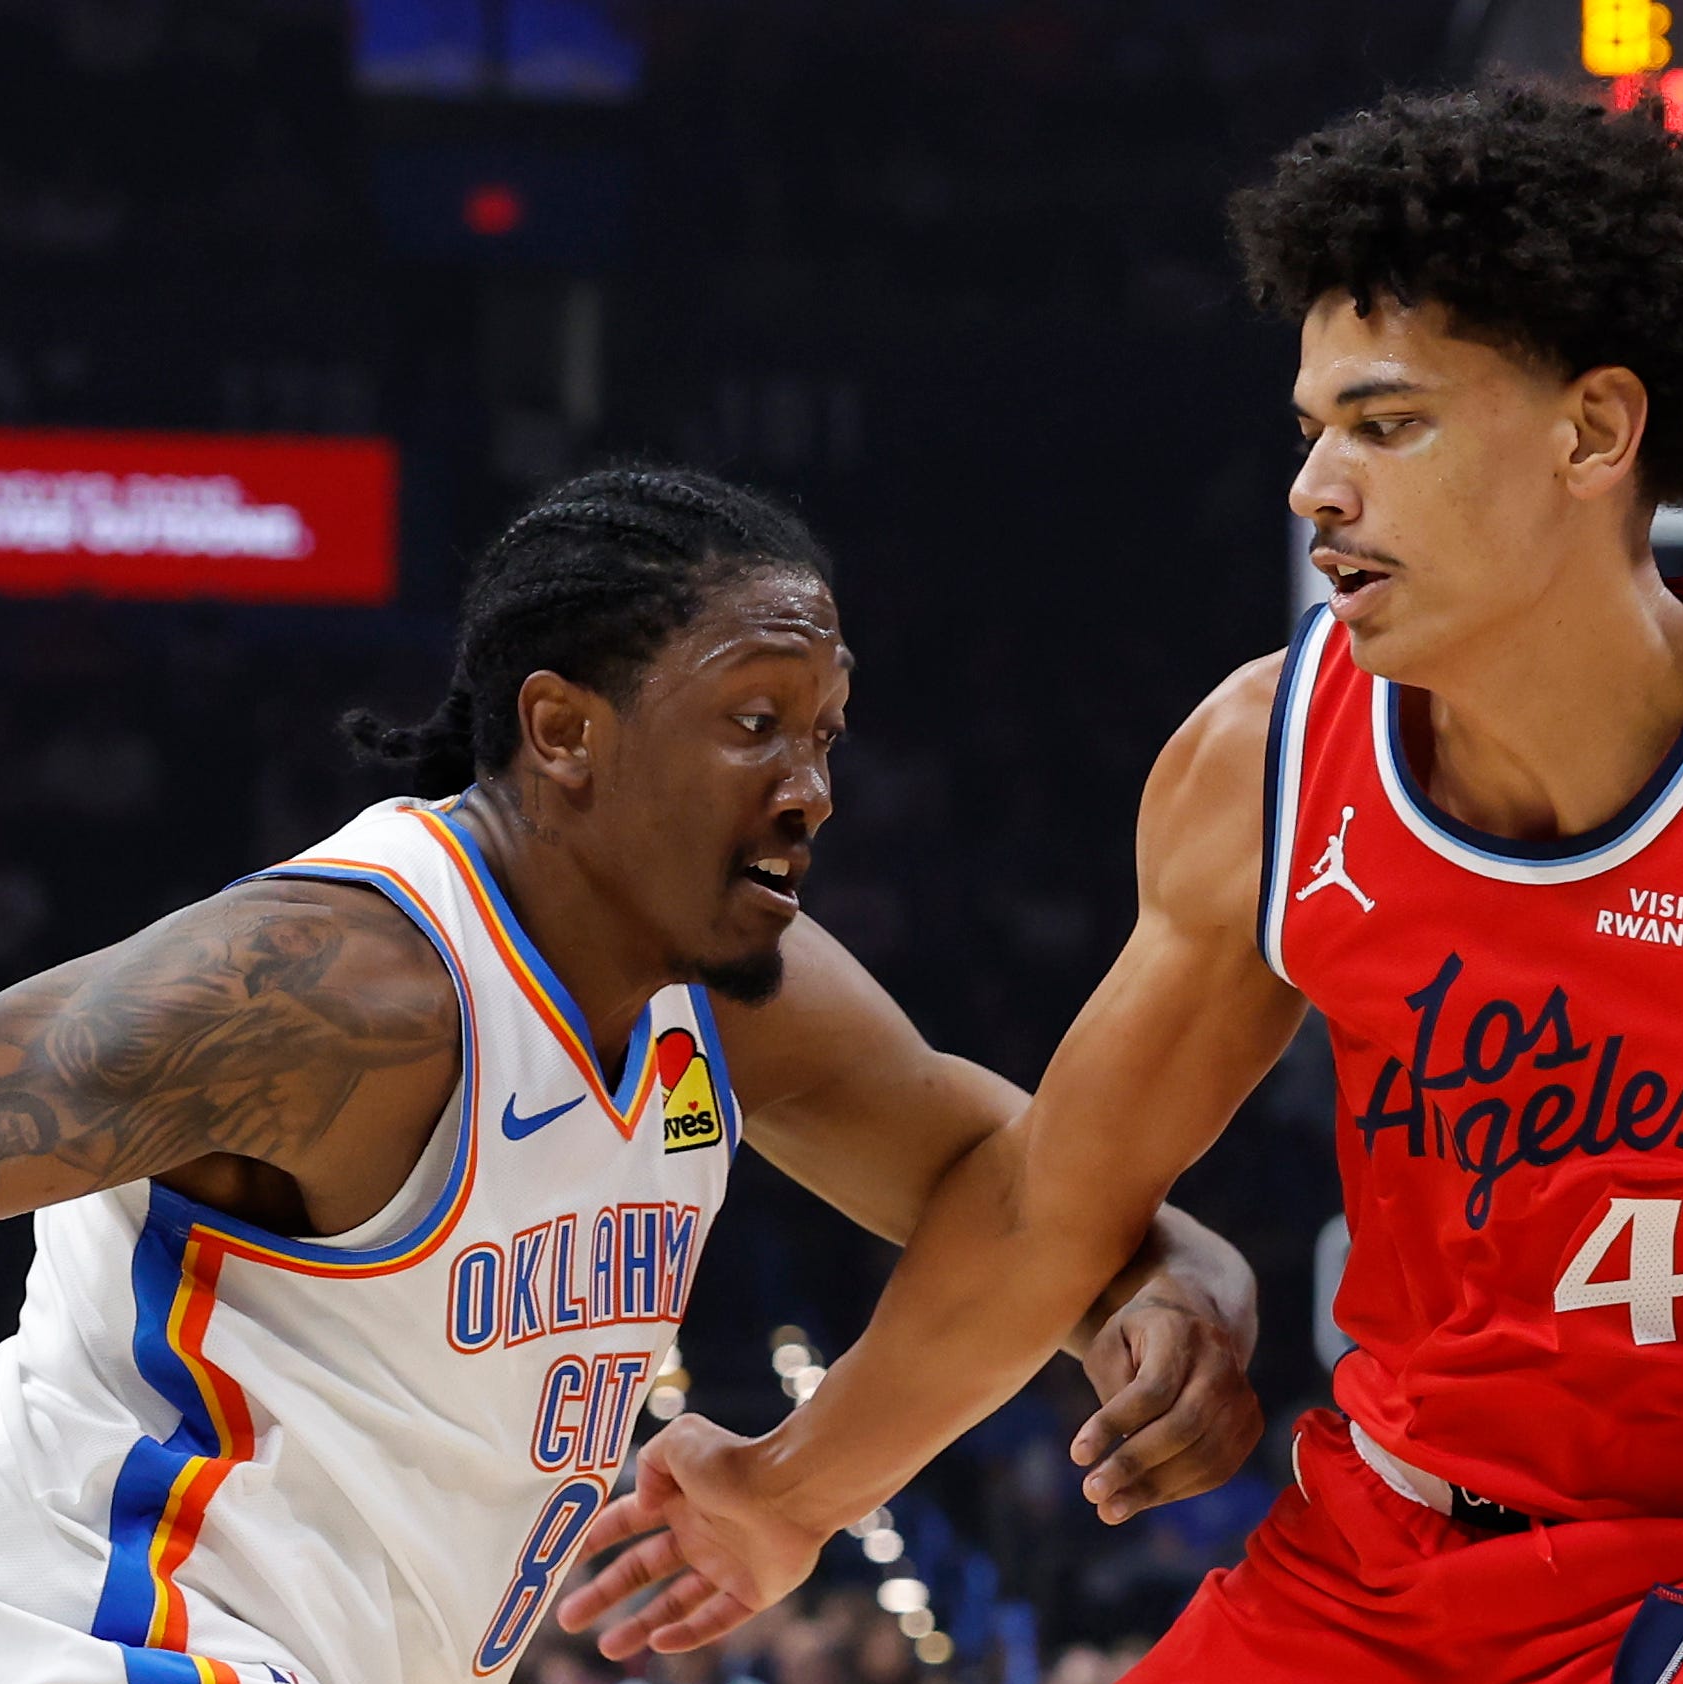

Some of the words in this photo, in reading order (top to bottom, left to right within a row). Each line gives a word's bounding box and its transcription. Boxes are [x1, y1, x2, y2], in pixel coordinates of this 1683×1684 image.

[1404, 951, 1591, 1090] Los
[446, 1200, 700, 1355] OKLAHM
[530, 1351, 662, 1473] CIT
[472, 1473, 609, 1677] 8
